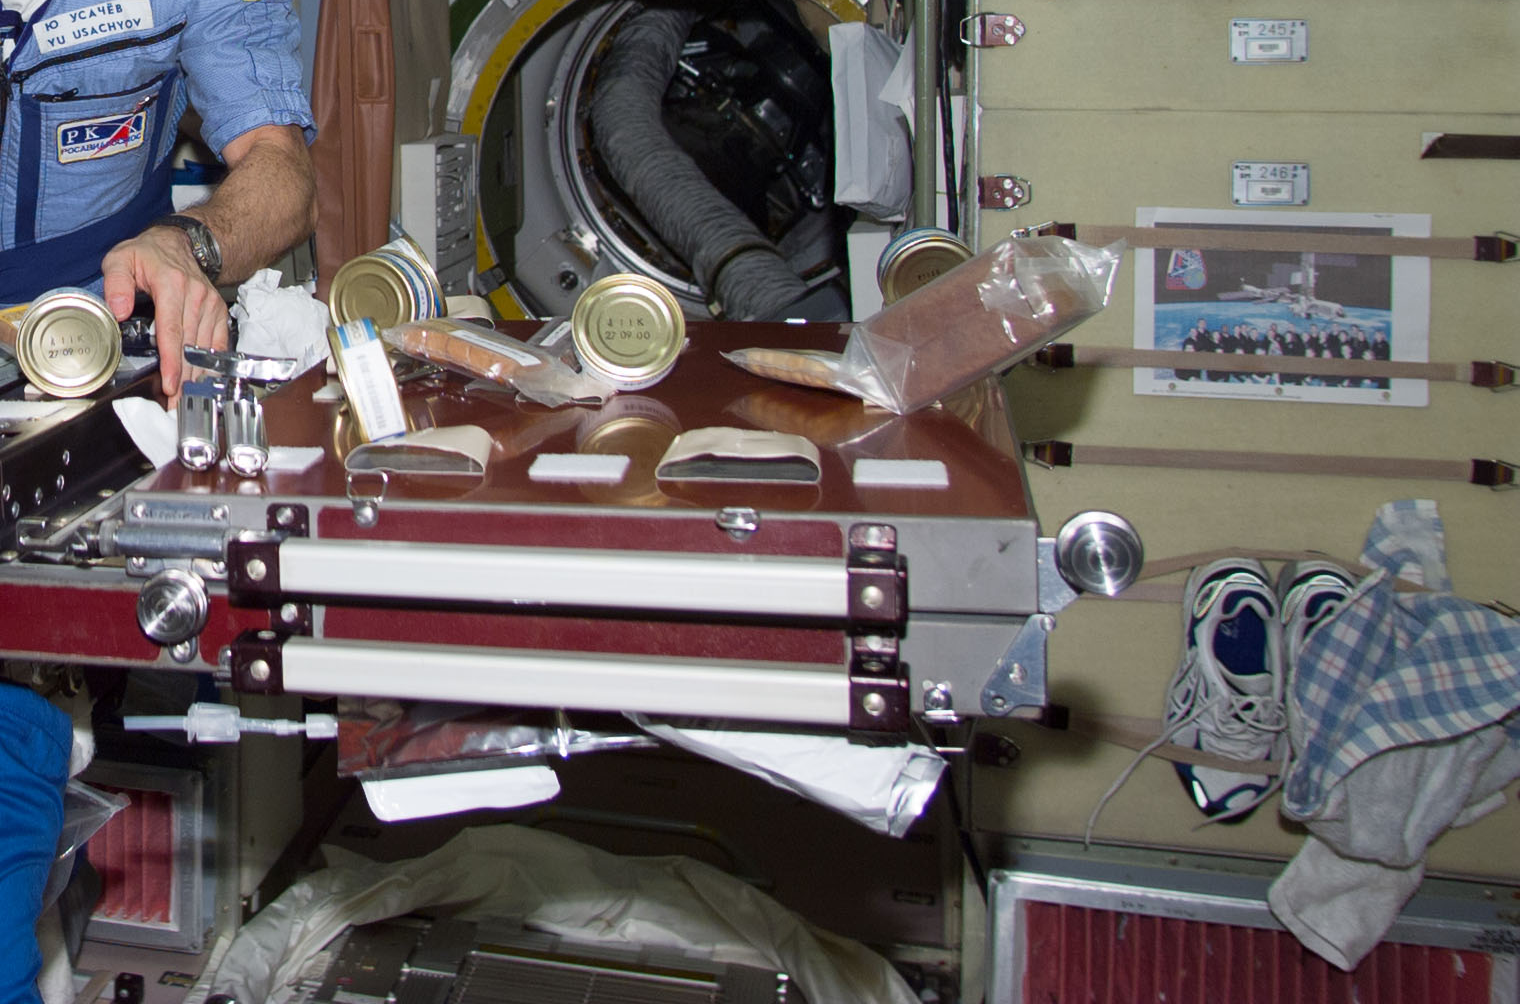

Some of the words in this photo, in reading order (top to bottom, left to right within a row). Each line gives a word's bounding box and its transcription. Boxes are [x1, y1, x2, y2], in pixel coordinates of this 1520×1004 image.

[45, 20, 58, 32] Ю
[69, 3, 123, 24] УСАЧЁВ
[47, 35, 66, 48] YU
[72, 17, 142, 40] USACHYOV
[1258, 24, 1287, 36] 245
[1259, 166, 1288, 180] 246
